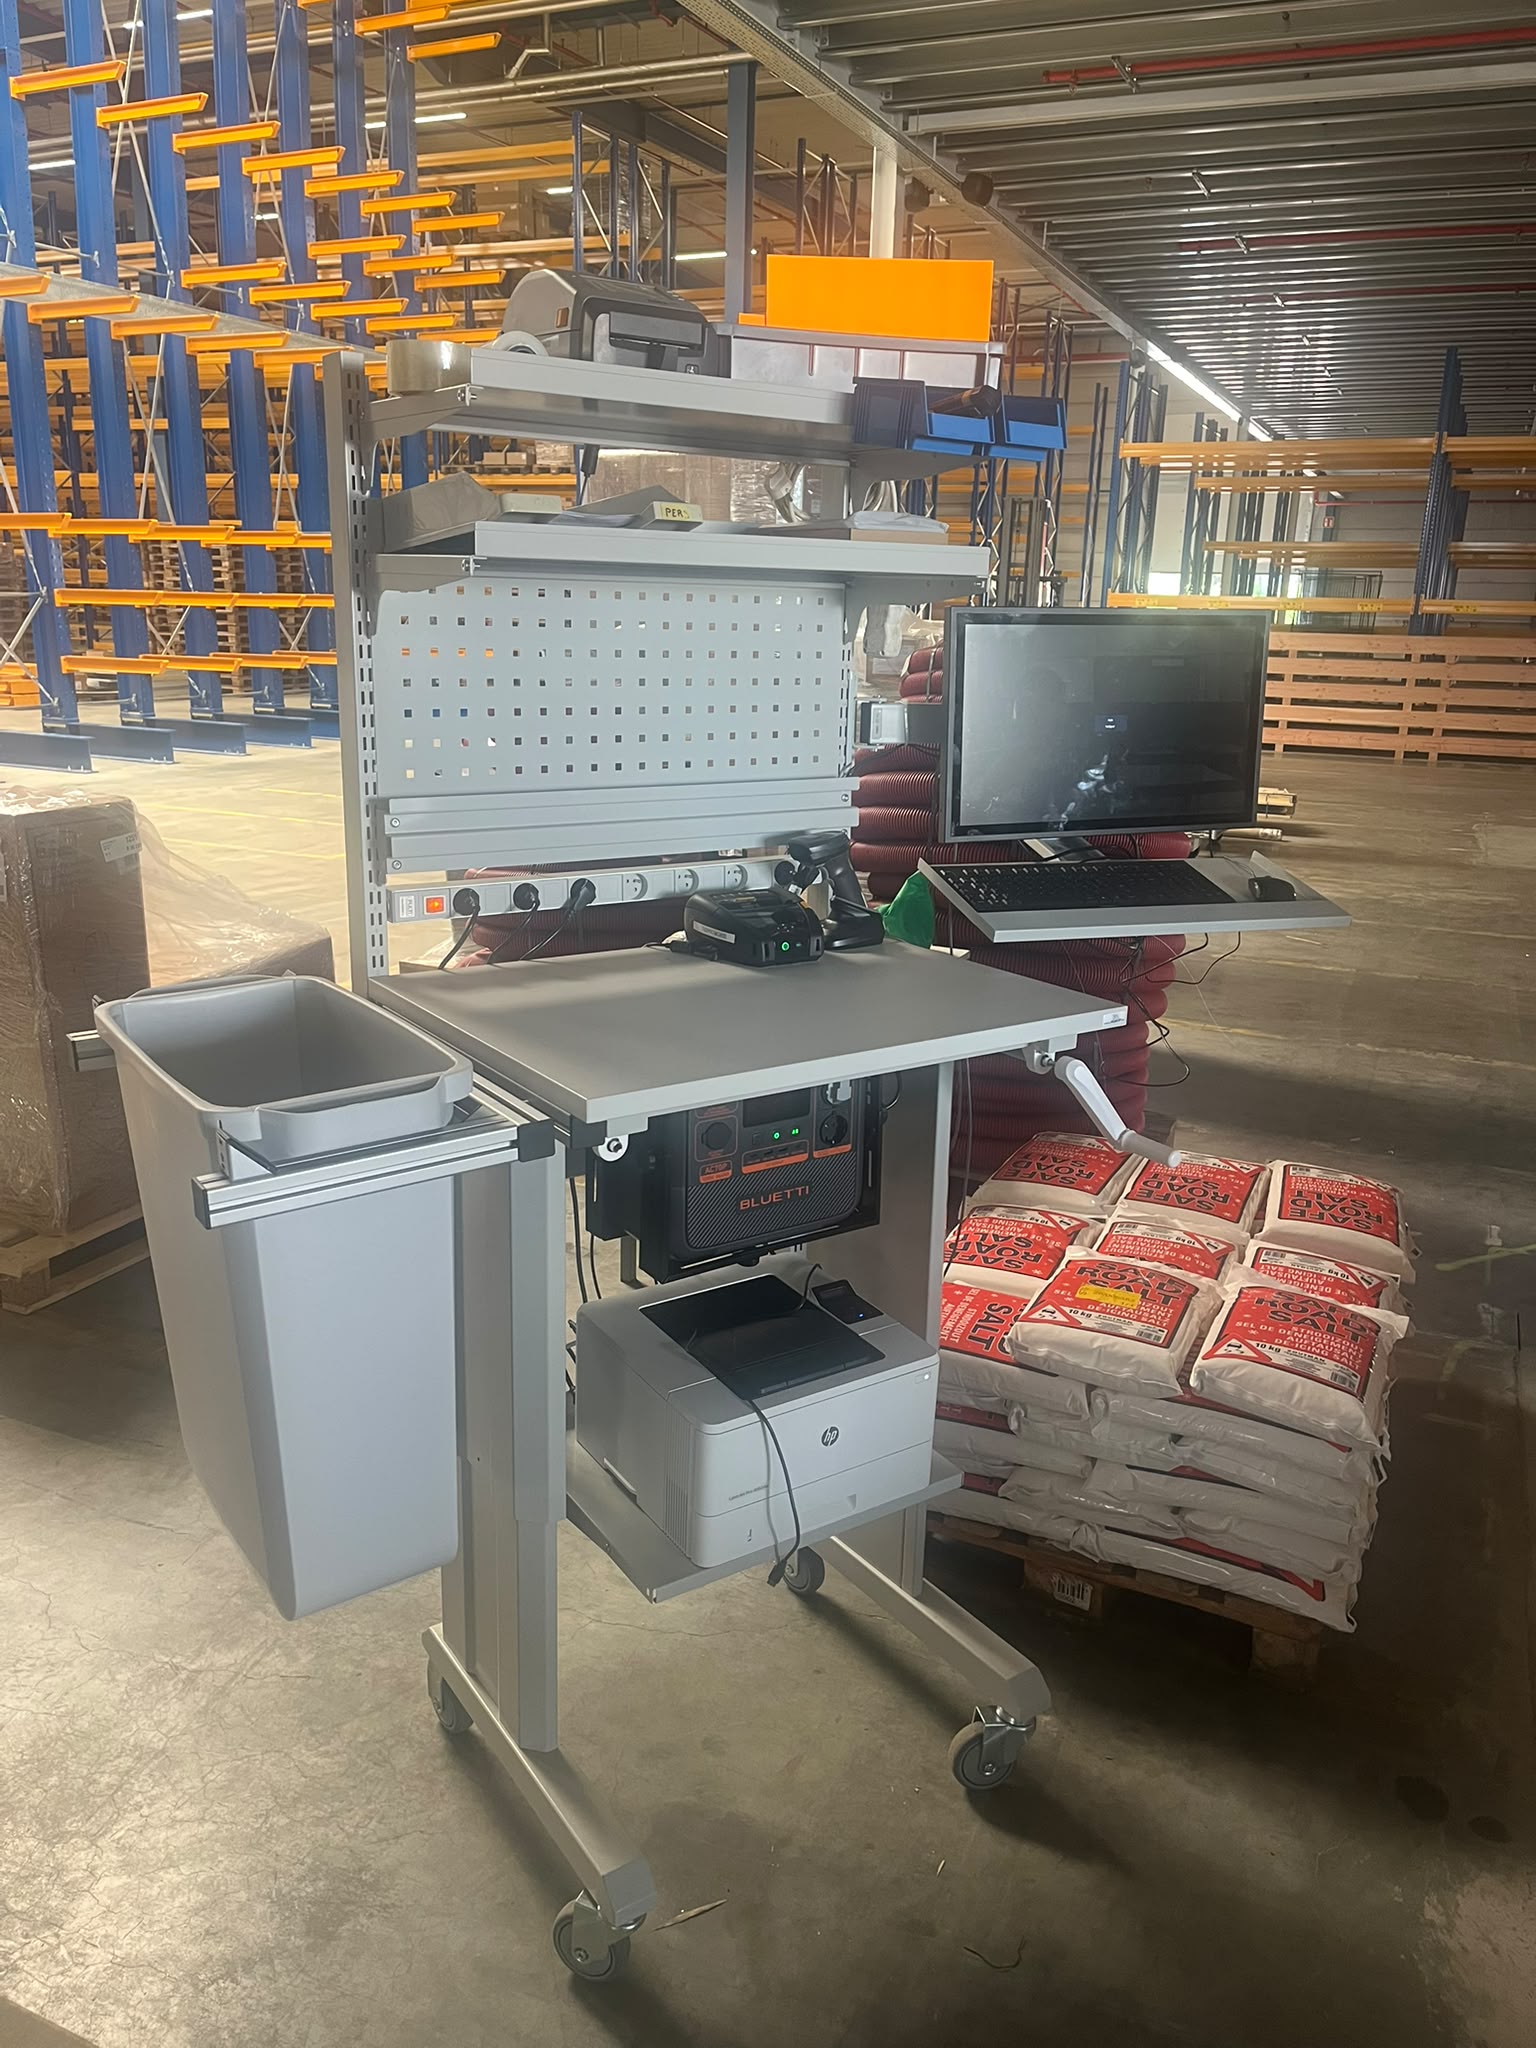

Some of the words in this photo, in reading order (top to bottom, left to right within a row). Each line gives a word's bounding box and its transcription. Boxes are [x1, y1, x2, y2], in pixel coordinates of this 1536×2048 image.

[1003, 1168, 1078, 1185] SAFE
[1011, 1160, 1095, 1180] ROAD
[739, 1185, 810, 1210] BLUETTI
[1135, 1187, 1216, 1211] SAFE
[1142, 1179, 1231, 1204] ROAD
[1294, 1190, 1369, 1209] SALT
[1289, 1198, 1382, 1225] ROAD
[1289, 1207, 1373, 1230] SAFE
[1045, 1240, 1062, 1248] SEL
[1175, 1236, 1186, 1244] kg
[948, 1240, 1043, 1263] ROAD
[1178, 1254, 1192, 1262] DE
[1076, 1266, 1183, 1295] ROAD
[1094, 1262, 1188, 1291] SAFE
[1327, 1268, 1339, 1277] kg
[1339, 1272, 1350, 1280] 10
[1053, 1289, 1072, 1297] SEL
[1068, 1308, 1079, 1316] 10
[1080, 1310, 1093, 1318] kg
[1087, 1304, 1138, 1320] DE-ICING
[1141, 1316, 1168, 1327] SALT
[967, 1303, 1014, 1351] SALT
[1235, 1321, 1257, 1330] SEL
[1268, 1310, 1368, 1343] SALT
[1267, 1345, 1281, 1353] kg
[1275, 1338, 1330, 1357] DE-ICING
[1332, 1354, 1360, 1370] SALT
[821, 1426, 840, 1447] hp
